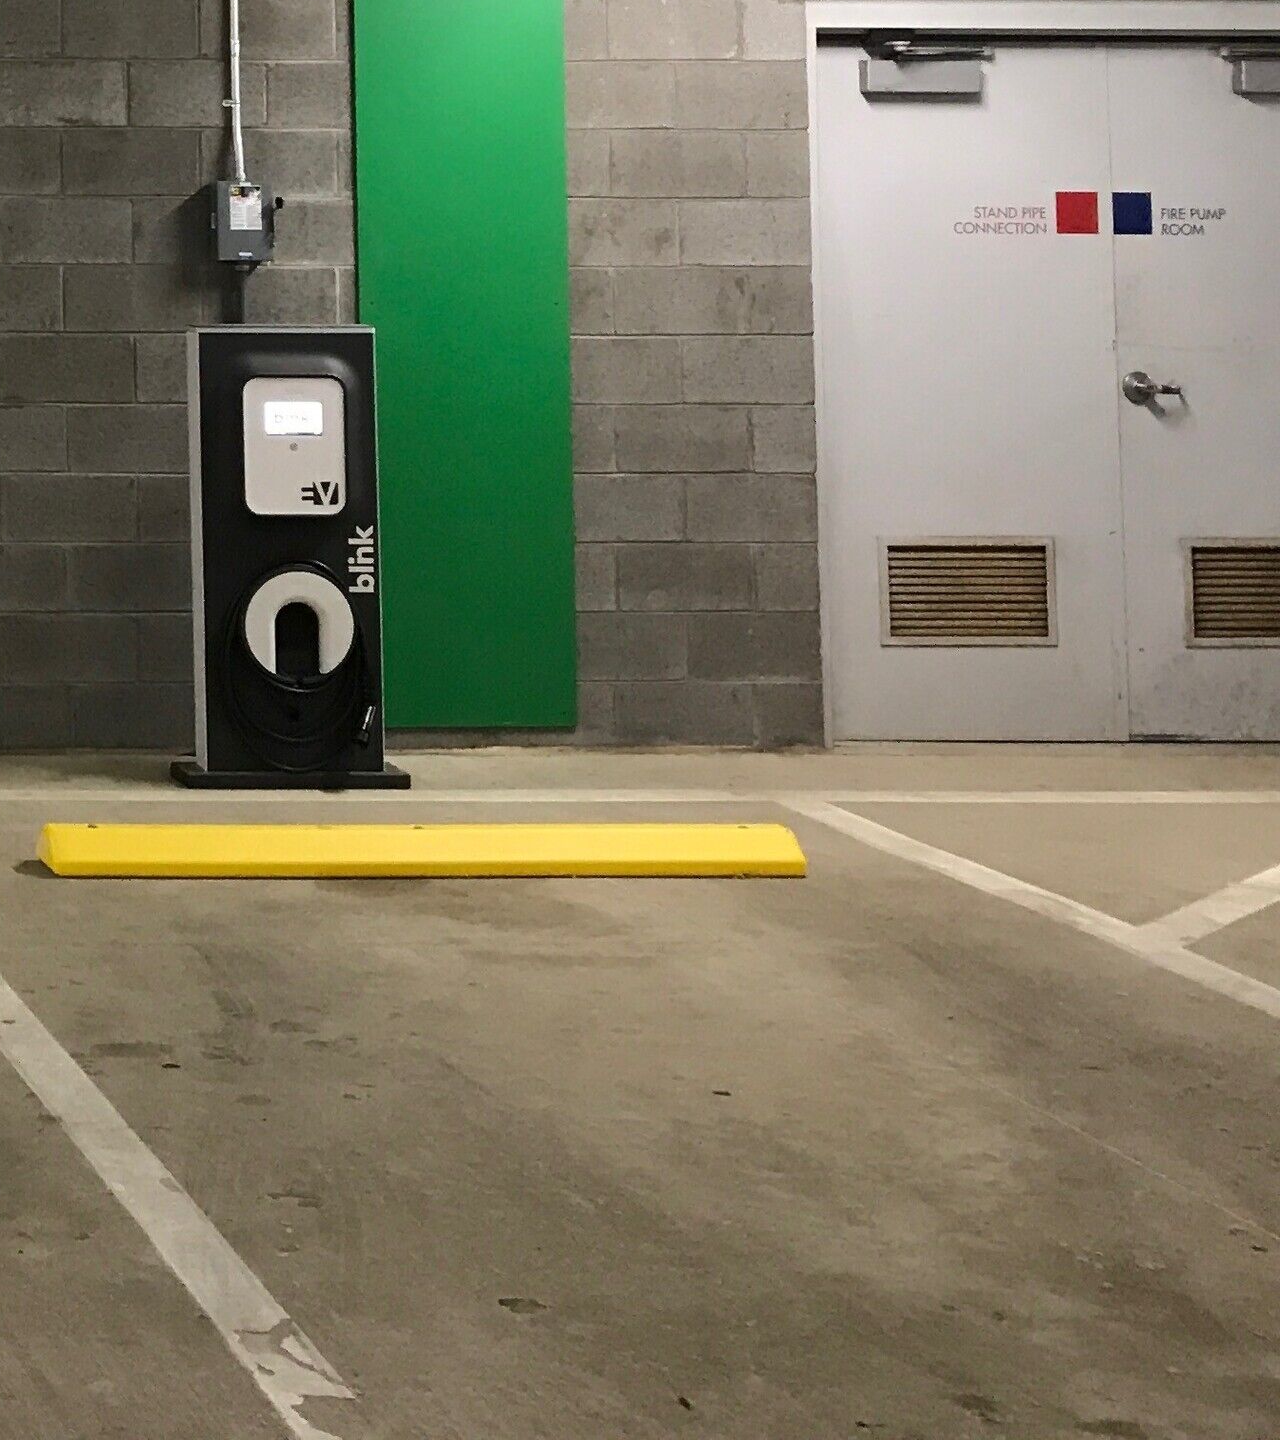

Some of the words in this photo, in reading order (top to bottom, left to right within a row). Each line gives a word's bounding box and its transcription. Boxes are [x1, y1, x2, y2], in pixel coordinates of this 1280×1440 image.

[973, 206, 1018, 219] STAND
[1022, 206, 1047, 219] PIPE
[1160, 207, 1186, 220] FIRE
[1190, 208, 1227, 221] PUMP
[953, 221, 1048, 235] CONNECTION
[1160, 223, 1205, 236] ROOM
[347, 525, 375, 593] blink
